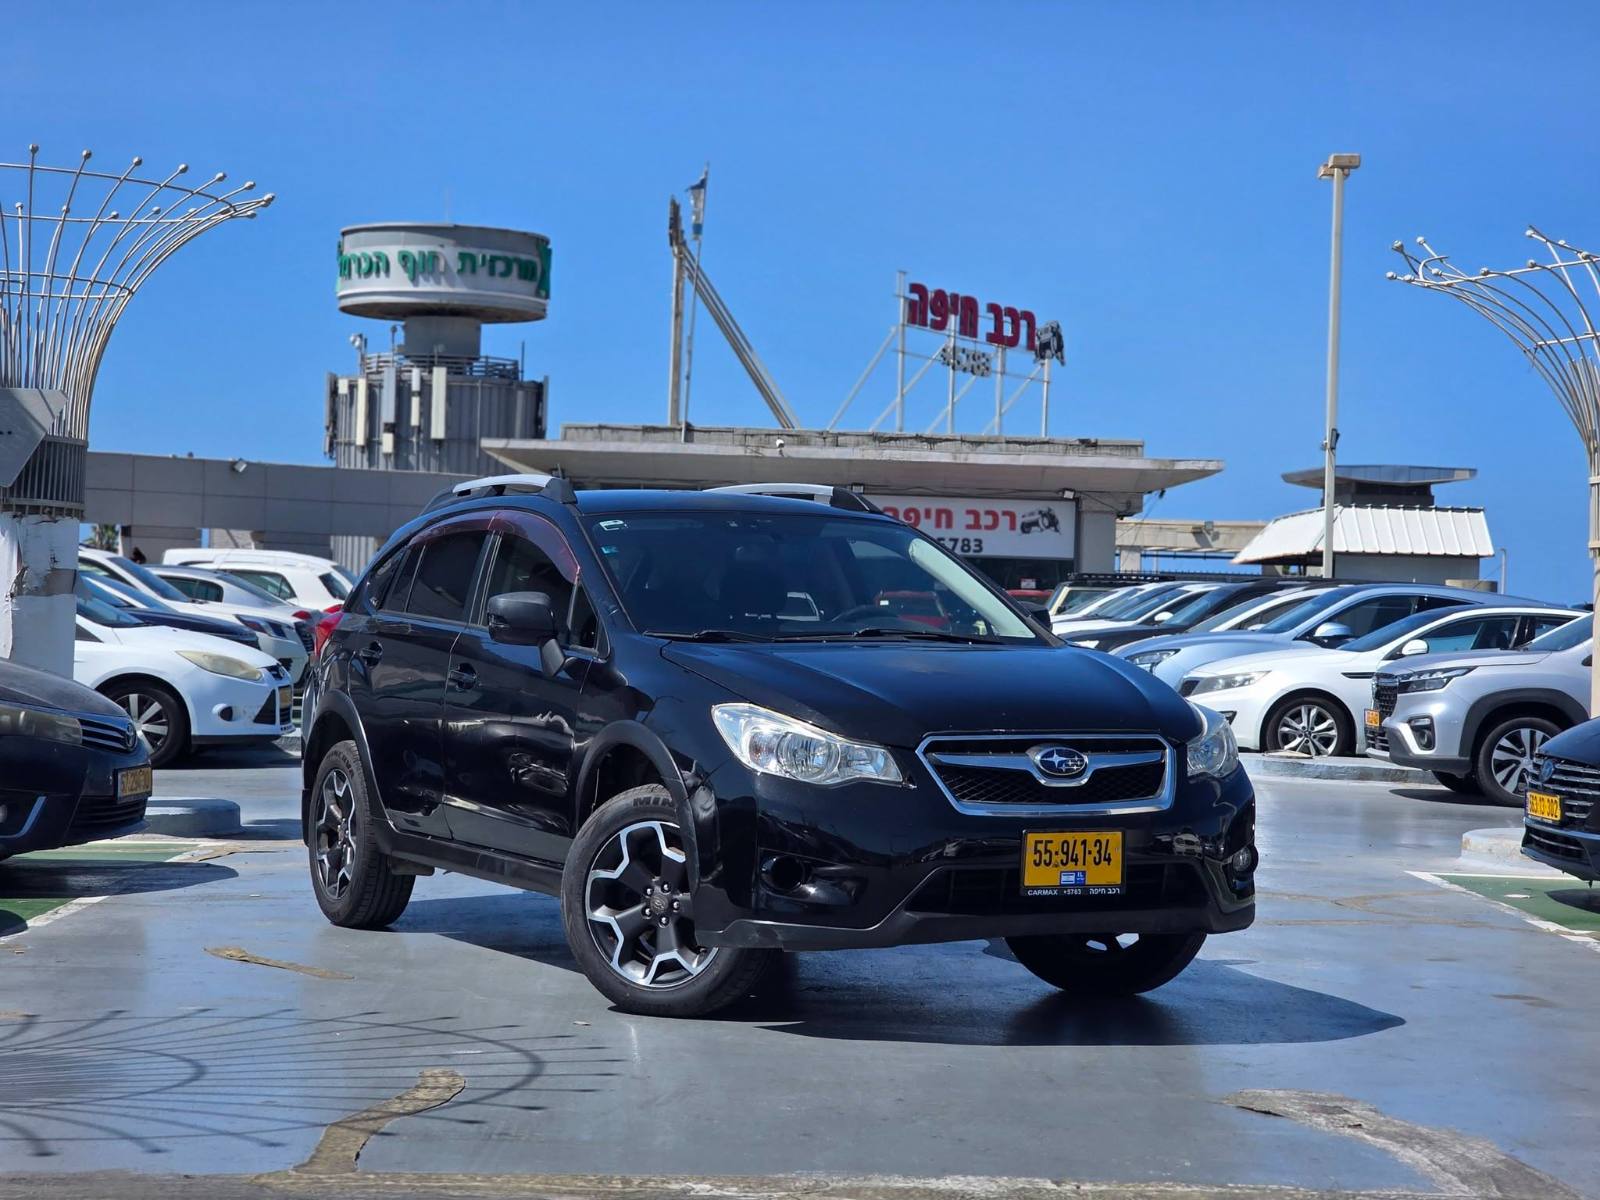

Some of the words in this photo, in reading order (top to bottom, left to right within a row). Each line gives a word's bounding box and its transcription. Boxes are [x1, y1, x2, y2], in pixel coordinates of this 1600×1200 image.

[338, 244, 391, 279] הכרמ
[397, 250, 446, 282] חוף
[907, 283, 979, 339] חיפה
[986, 302, 1037, 352] רכב
[965, 509, 1017, 531] רכב
